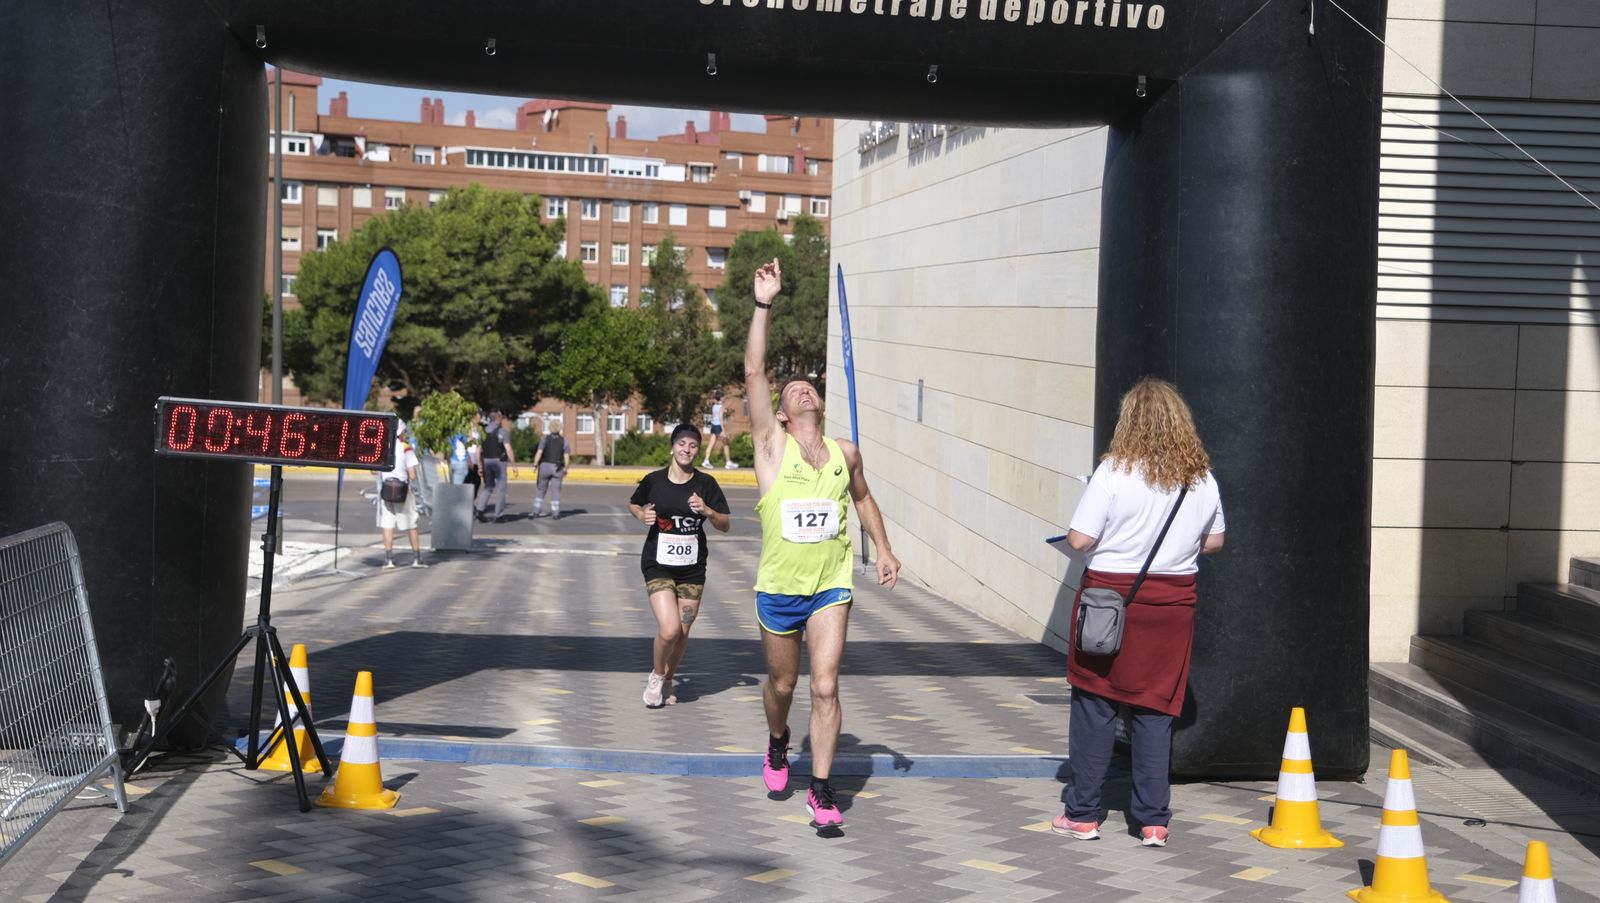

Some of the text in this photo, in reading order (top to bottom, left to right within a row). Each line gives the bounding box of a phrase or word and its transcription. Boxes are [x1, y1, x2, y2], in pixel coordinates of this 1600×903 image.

[699, 0, 1165, 29] metraje deportivo
[168, 406, 385, 463] 00:46:19
[794, 512, 828, 527] 127
[667, 544, 692, 556] 208
